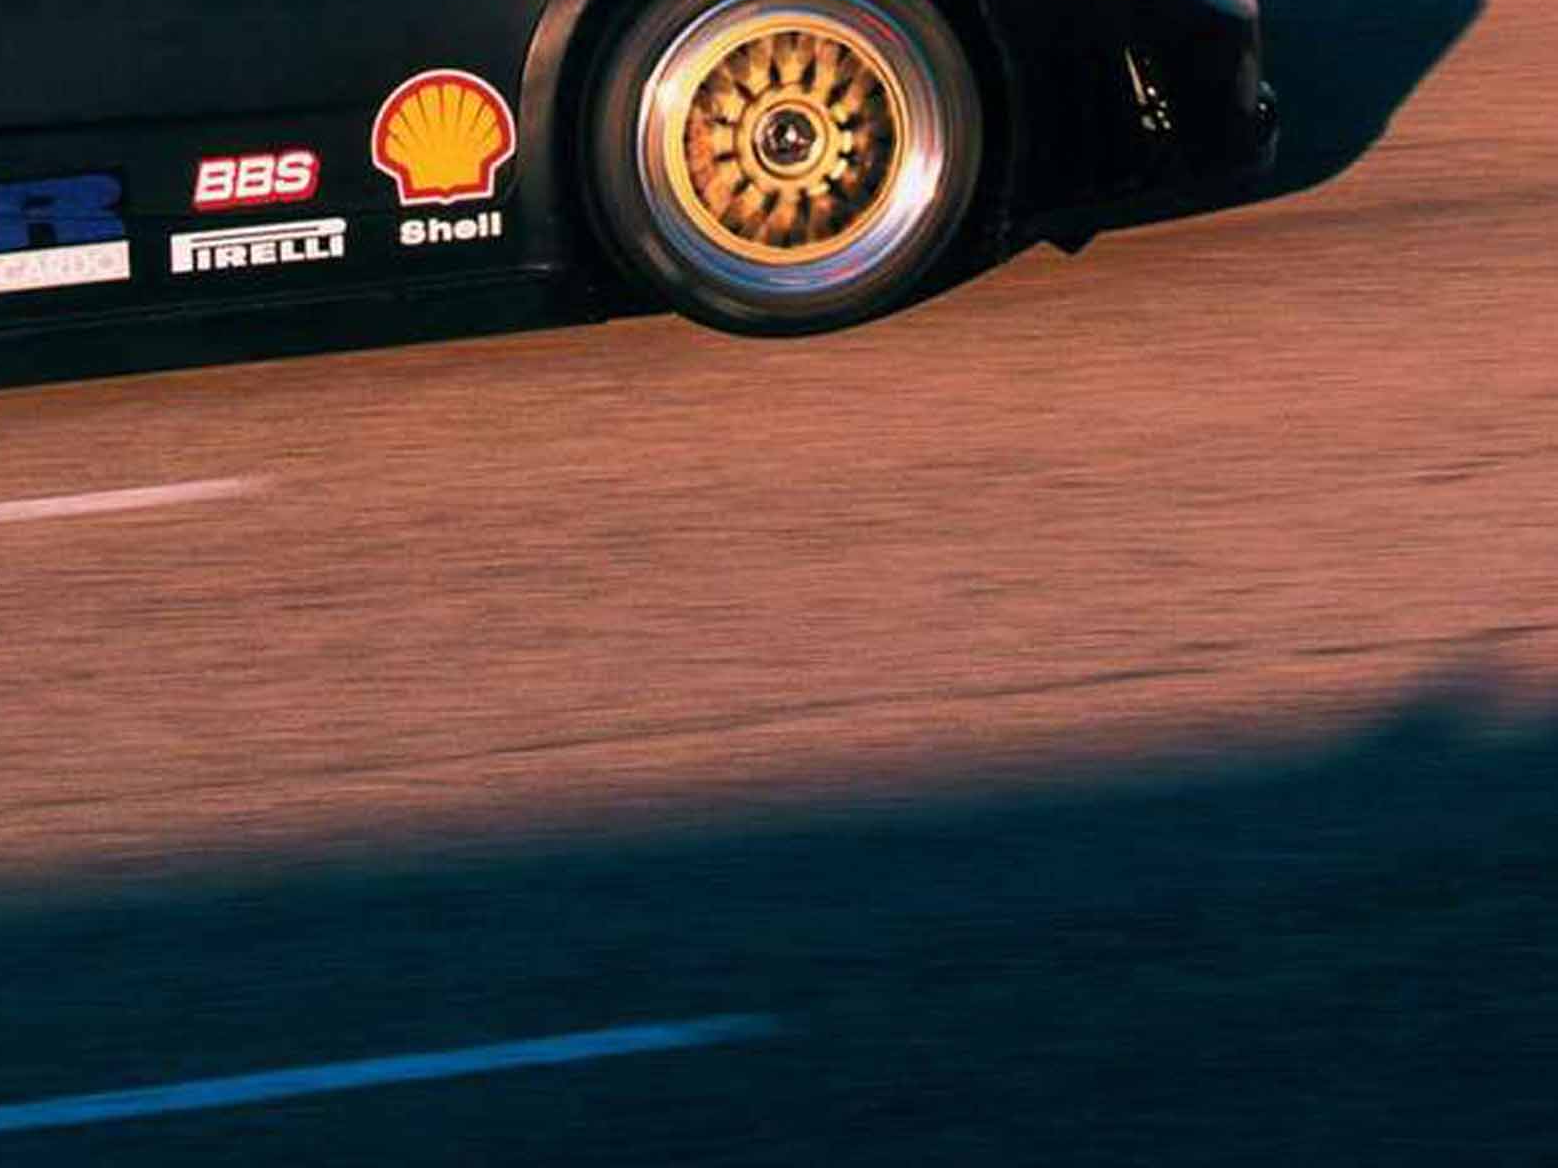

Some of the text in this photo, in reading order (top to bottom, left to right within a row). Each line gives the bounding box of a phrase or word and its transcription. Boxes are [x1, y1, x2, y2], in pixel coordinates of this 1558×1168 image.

[193, 147, 319, 210] BBS
[170, 218, 347, 273] PIRELLI
[399, 211, 502, 246] Shell
